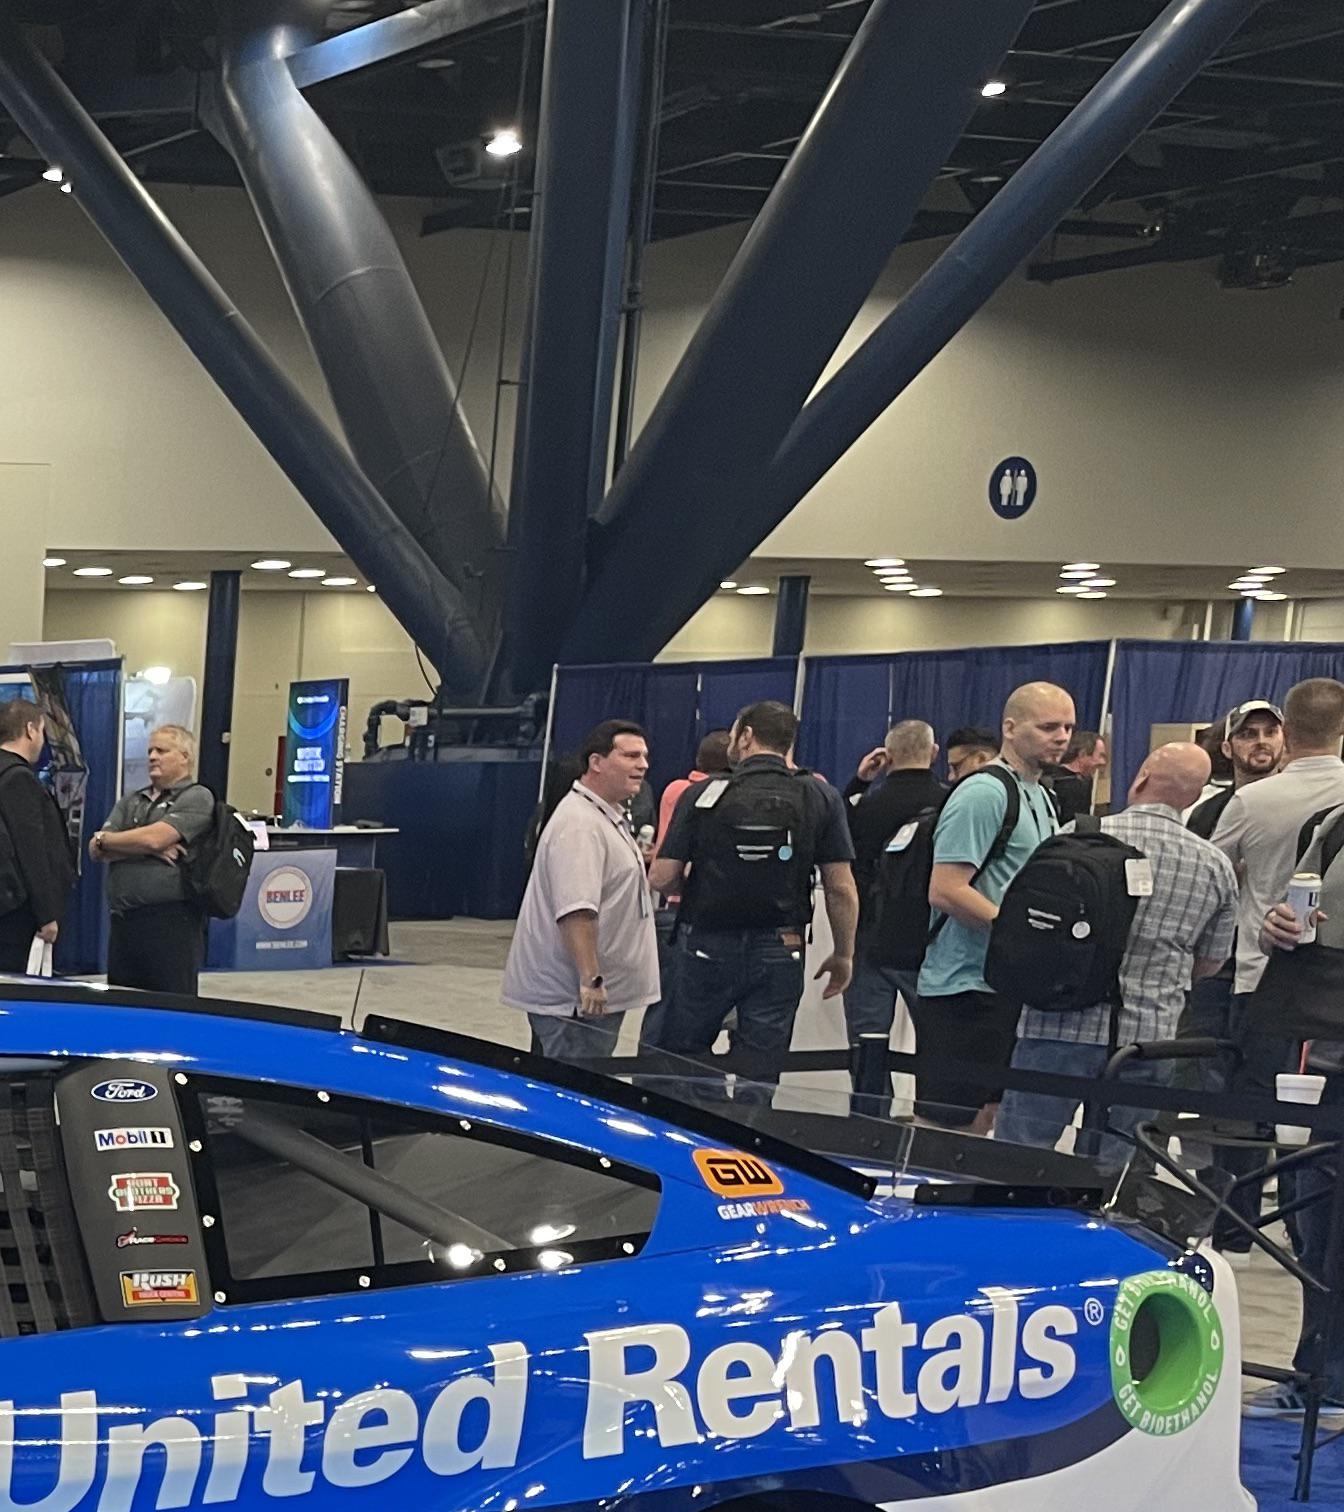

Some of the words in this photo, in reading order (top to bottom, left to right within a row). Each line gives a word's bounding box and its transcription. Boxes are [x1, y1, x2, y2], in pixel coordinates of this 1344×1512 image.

[265, 889, 305, 904] BENLEE
[104, 1083, 146, 1099] Ford
[98, 1130, 148, 1148] Mobil
[706, 1158, 773, 1186] GW
[132, 1272, 188, 1290] RUSH
[1118, 1383, 1143, 1418] GET
[1139, 1369, 1219, 1434] BIOETHANOL
